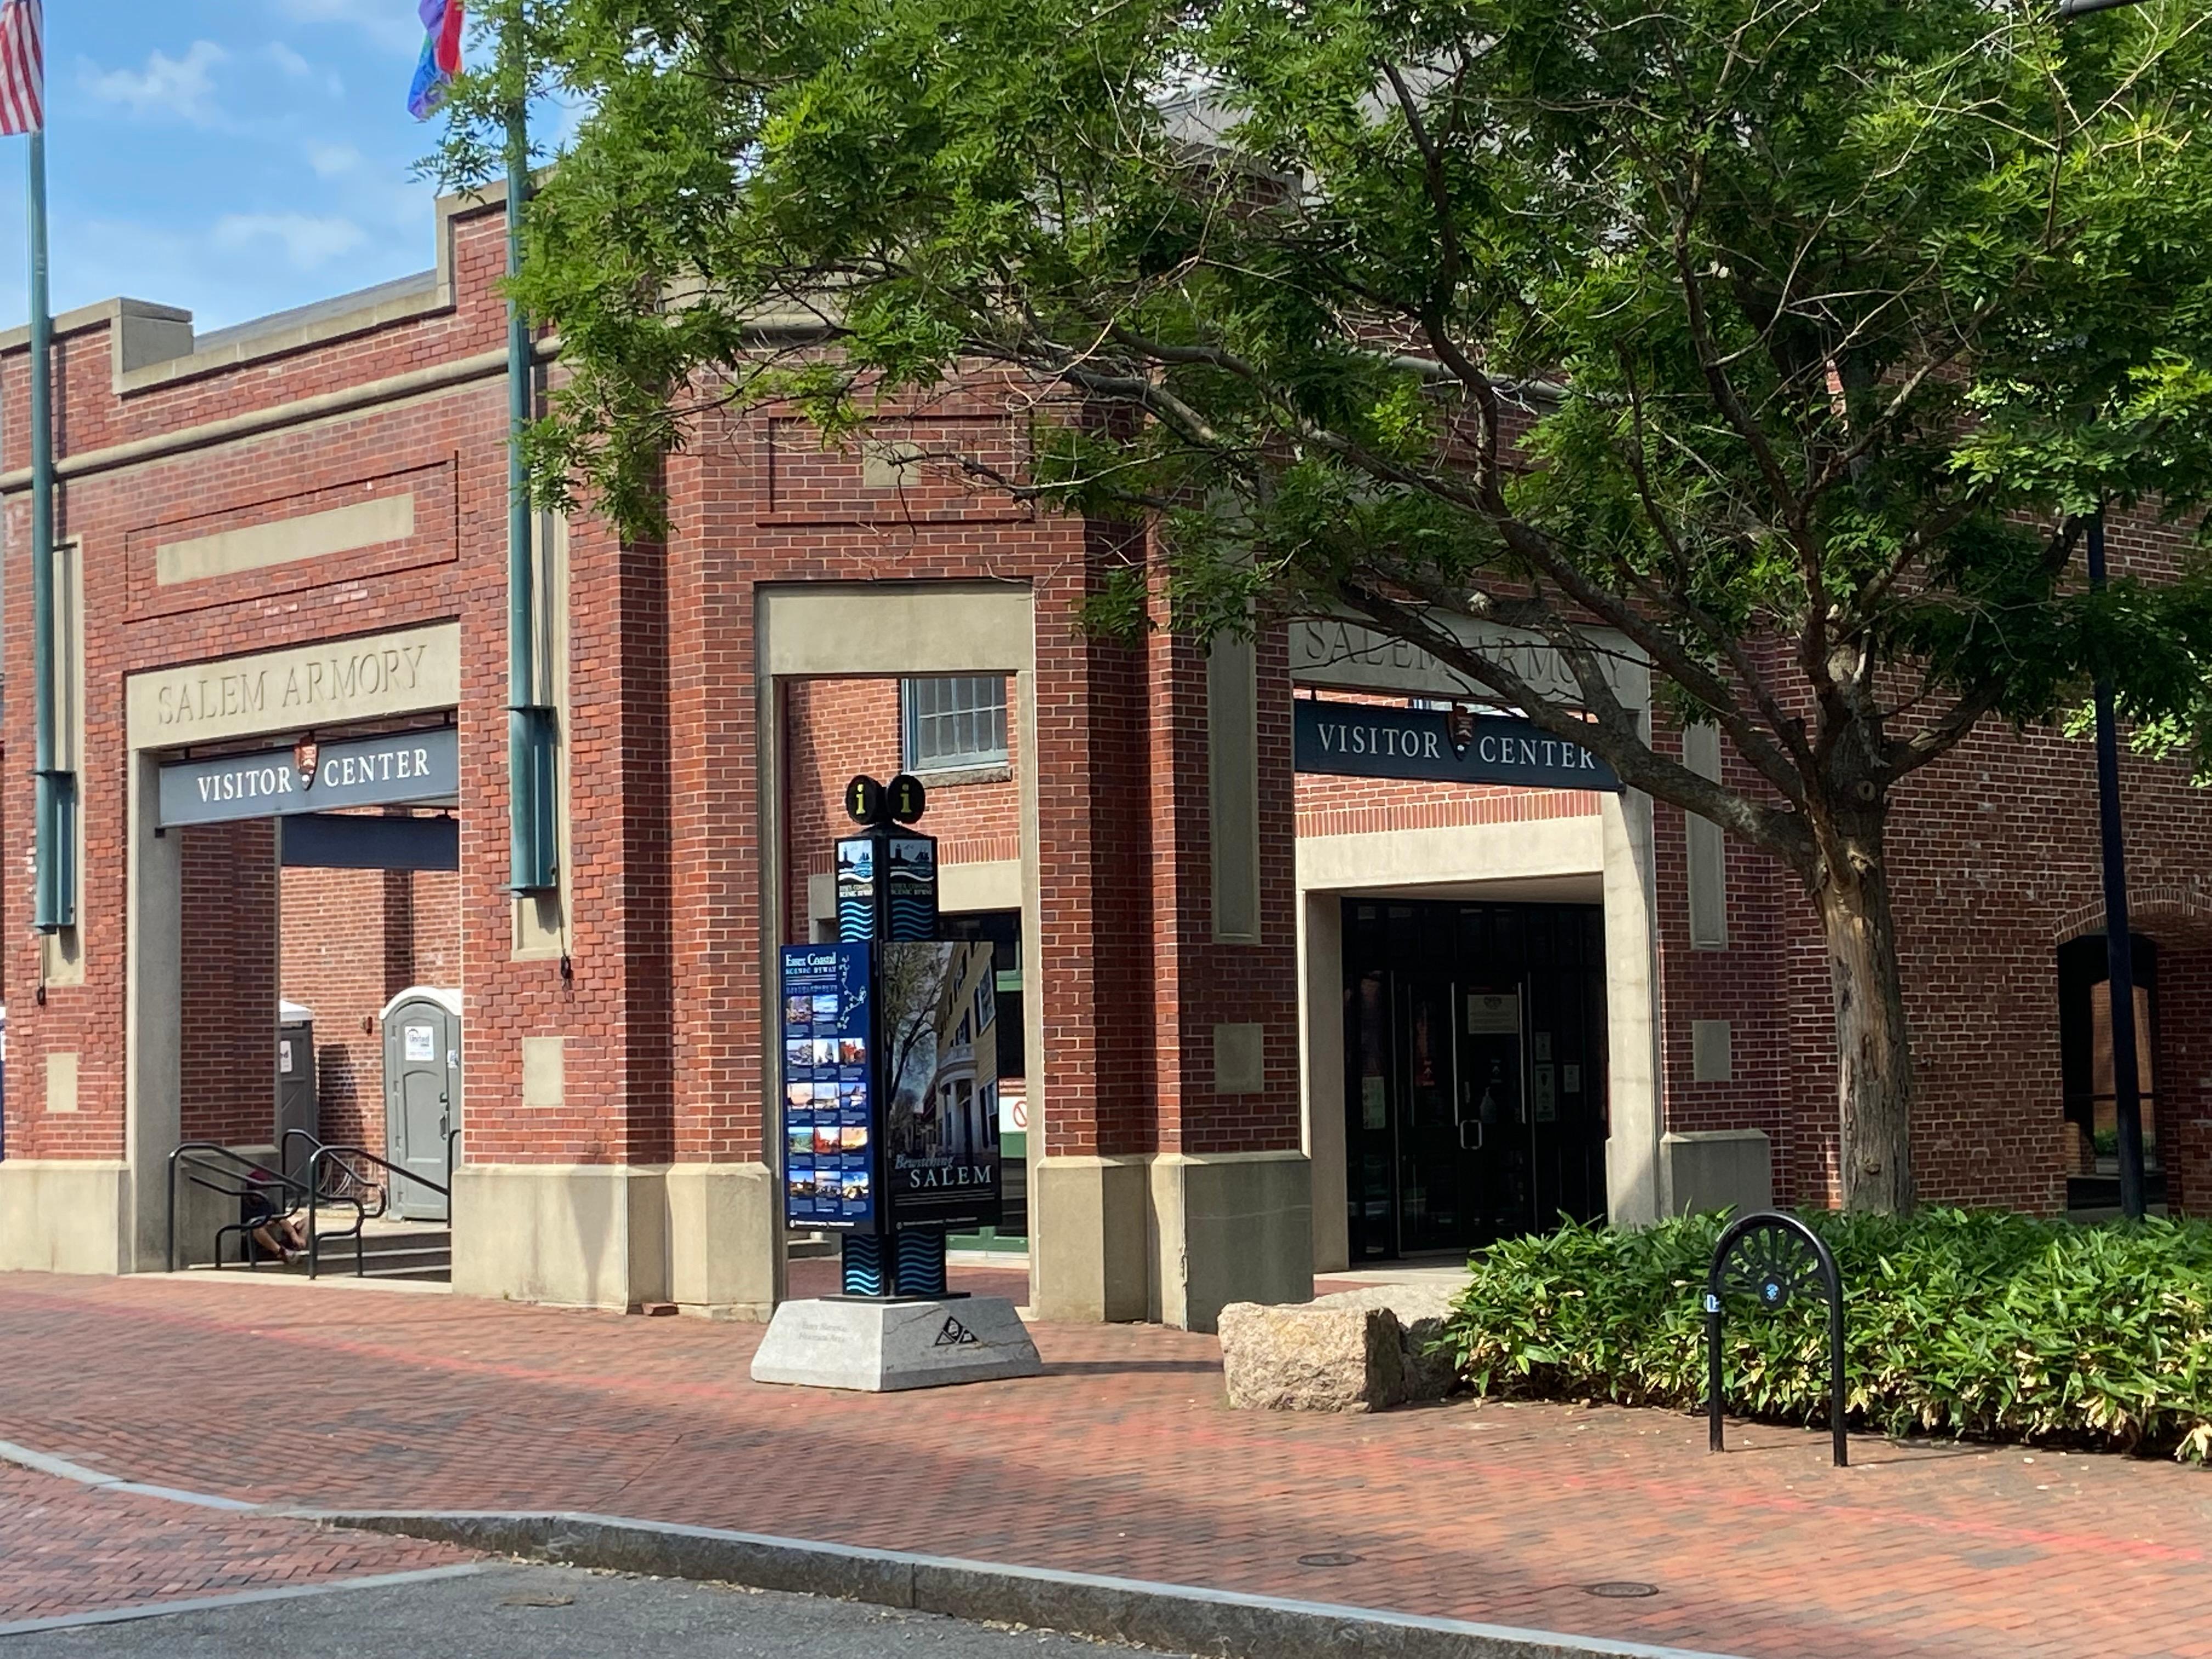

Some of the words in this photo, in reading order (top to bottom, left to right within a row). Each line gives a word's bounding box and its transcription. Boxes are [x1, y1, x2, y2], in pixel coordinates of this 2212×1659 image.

[159, 670, 268, 725] SALEM
[282, 645, 427, 707] ARMORY
[1475, 635, 1626, 689] RMOY
[1317, 723, 1441, 759] VISITOR
[1479, 735, 1596, 770] CENTER
[198, 766, 293, 803] VISITOR
[324, 748, 430, 788] CENTER
[856, 783, 866, 815] i
[900, 783, 912, 813] i
[910, 1165, 992, 1188] SALEM
